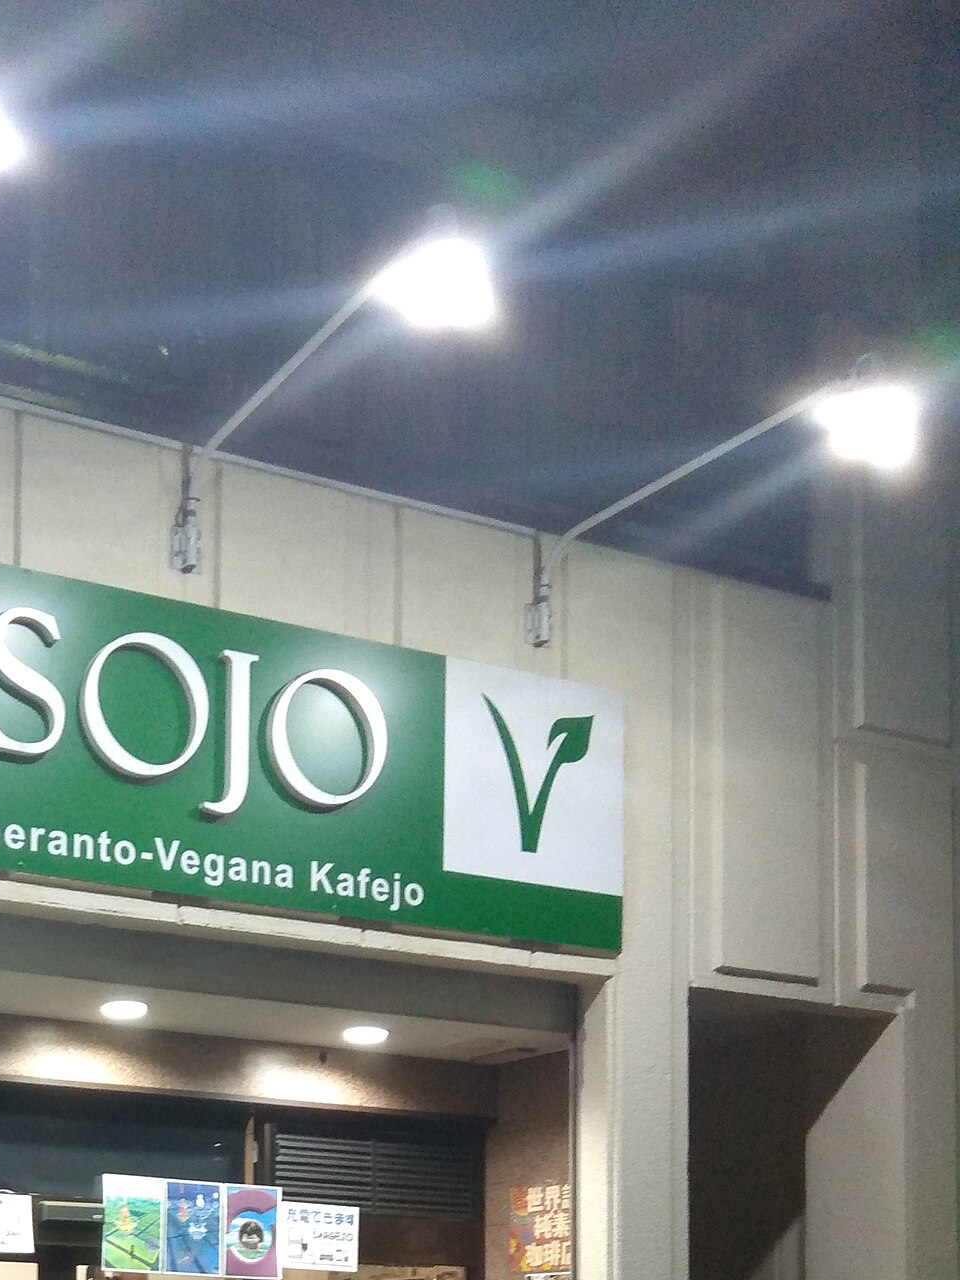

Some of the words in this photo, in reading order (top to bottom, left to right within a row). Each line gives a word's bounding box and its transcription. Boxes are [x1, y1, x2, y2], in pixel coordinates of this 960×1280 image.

[309, 860, 425, 912] Kafejo
[286, 1208, 355, 1226] 充電できます
